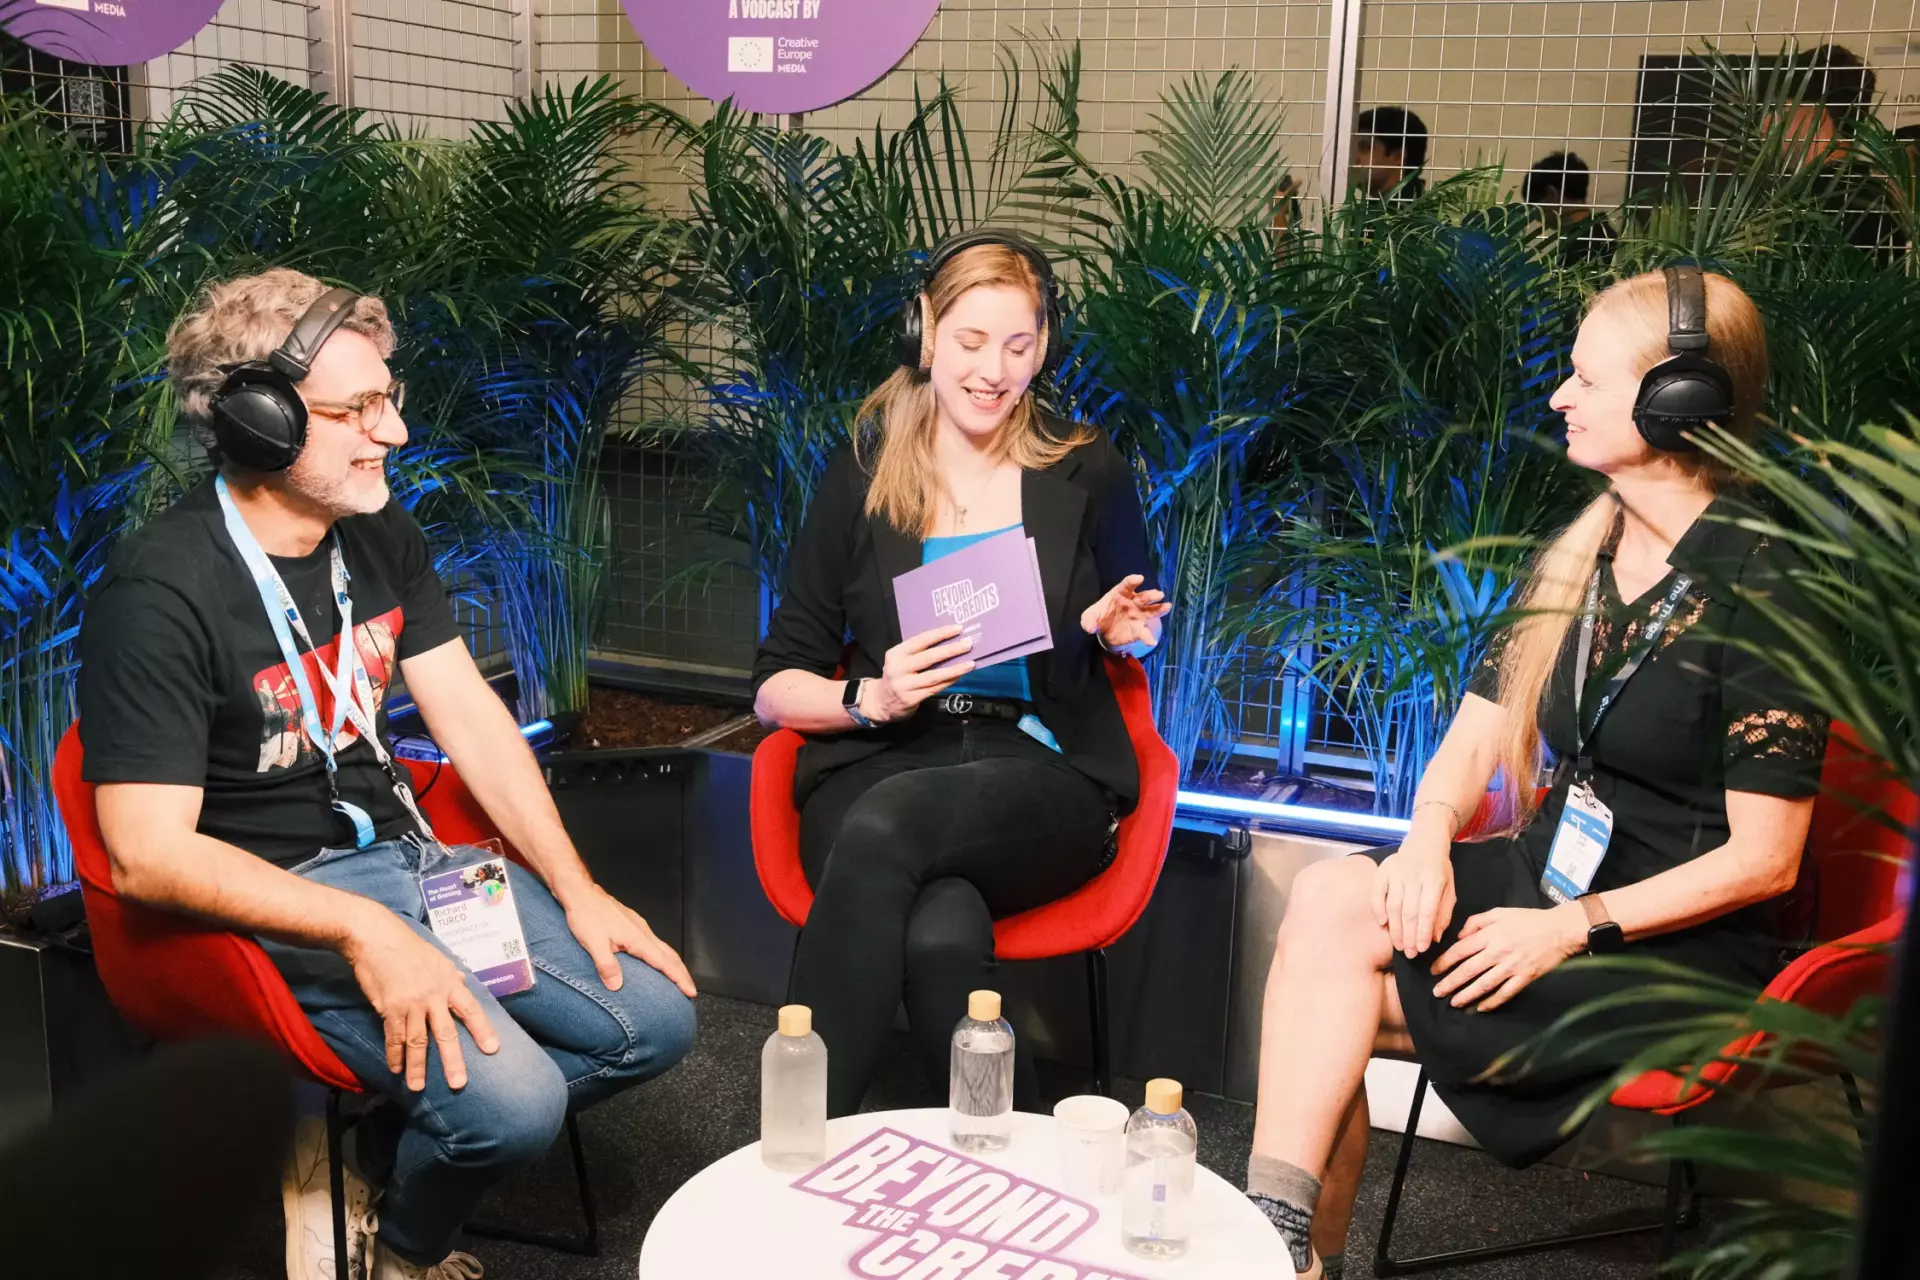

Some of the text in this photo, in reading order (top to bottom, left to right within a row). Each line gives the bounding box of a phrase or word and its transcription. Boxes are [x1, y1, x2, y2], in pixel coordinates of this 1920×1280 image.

[94, 2, 127, 17] MEDIA
[728, 0, 821, 19] A VODCAST BY
[778, 37, 819, 48] Creative
[778, 49, 813, 62] Europe
[778, 64, 807, 73] MEDIA
[933, 581, 973, 614] BEYOND
[1669, 579, 1689, 601] The
[956, 584, 998, 622] CREDITS
[427, 889, 439, 897] The
[436, 890, 462, 901] Gaming
[434, 903, 467, 919] Richard
[437, 913, 467, 927] TURCO
[802, 1132, 1090, 1253] BEYOND
[856, 1204, 920, 1233] THE
